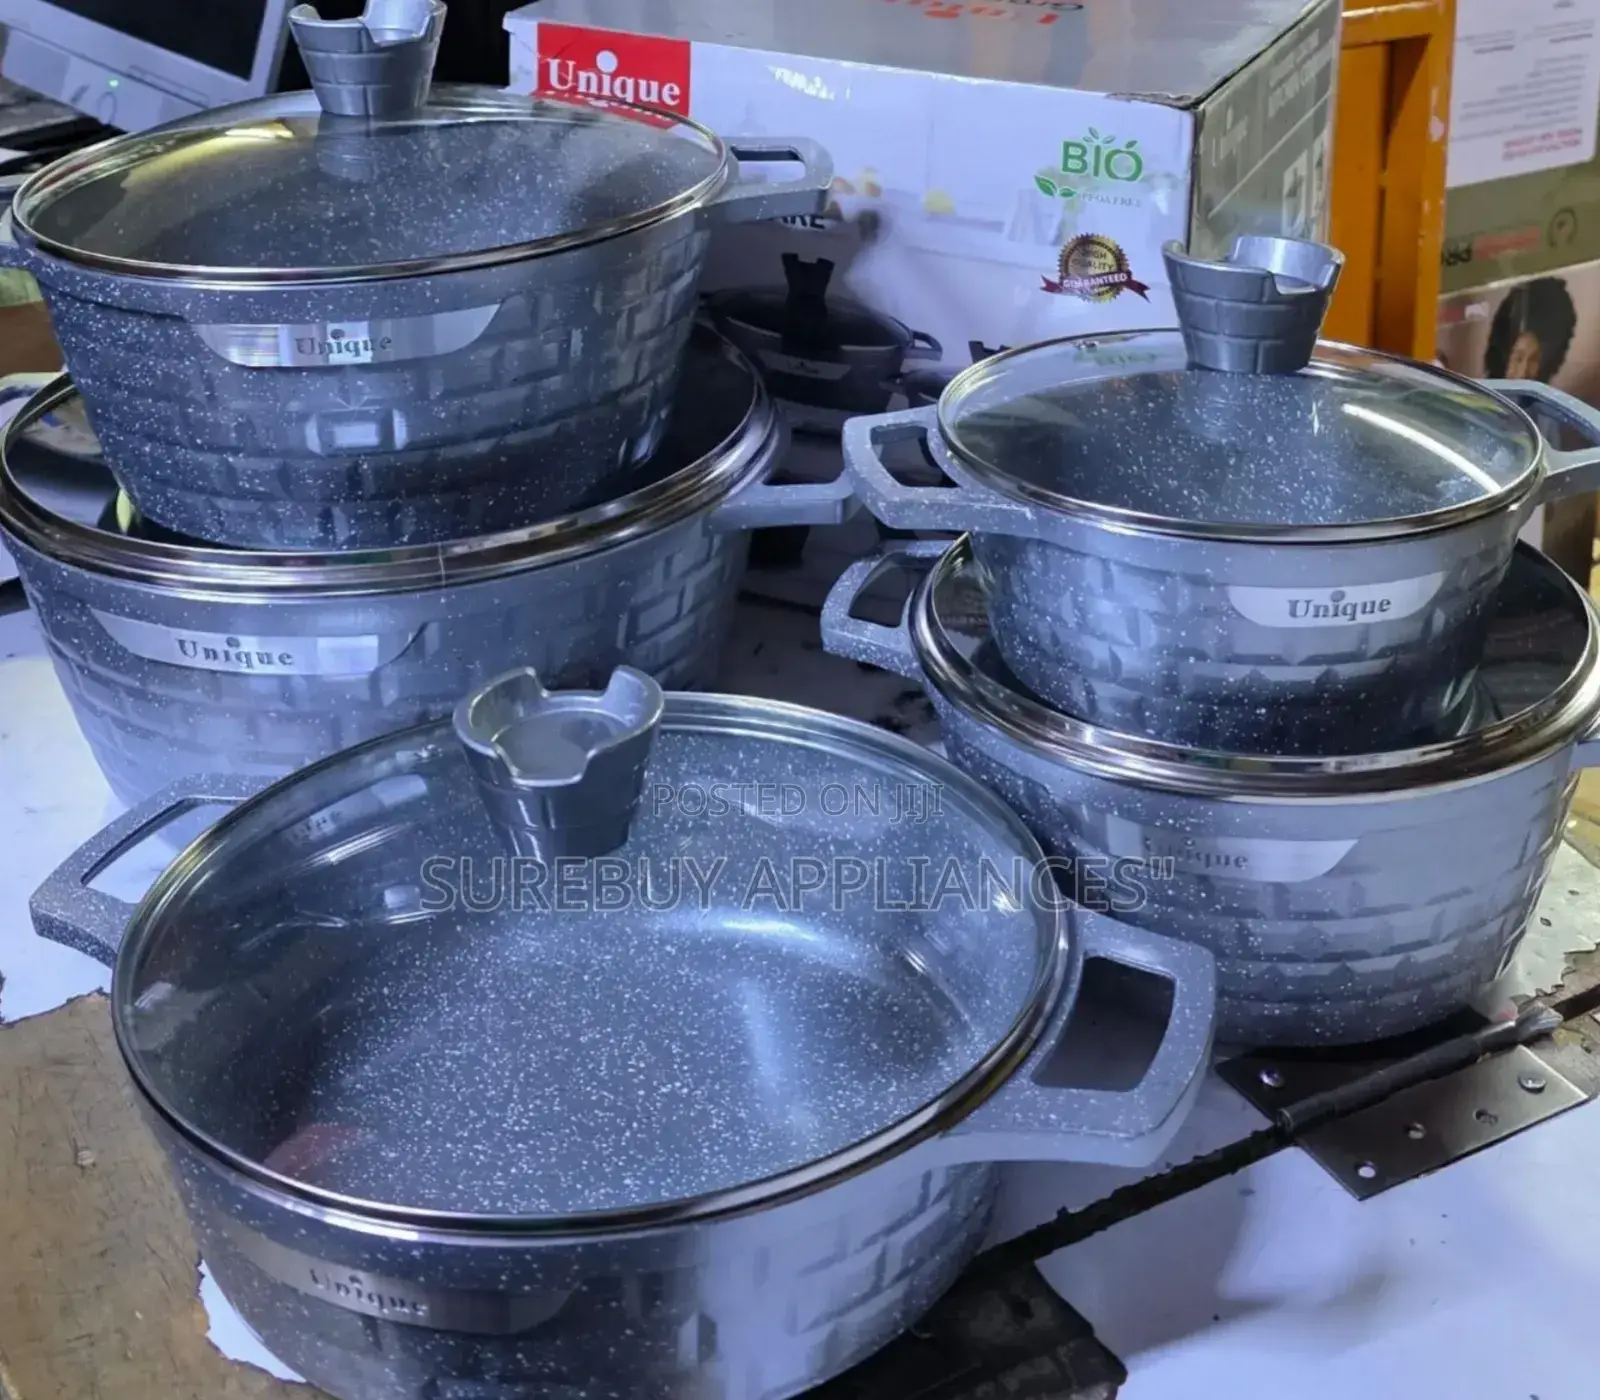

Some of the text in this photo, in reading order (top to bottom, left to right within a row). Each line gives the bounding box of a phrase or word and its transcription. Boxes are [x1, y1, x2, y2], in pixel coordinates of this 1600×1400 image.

[547, 50, 681, 107] Unique
[1063, 273, 1128, 289] GUARANTEED
[295, 329, 392, 358] Unique
[1287, 589, 1391, 621] Unique
[177, 637, 293, 669] Unique
